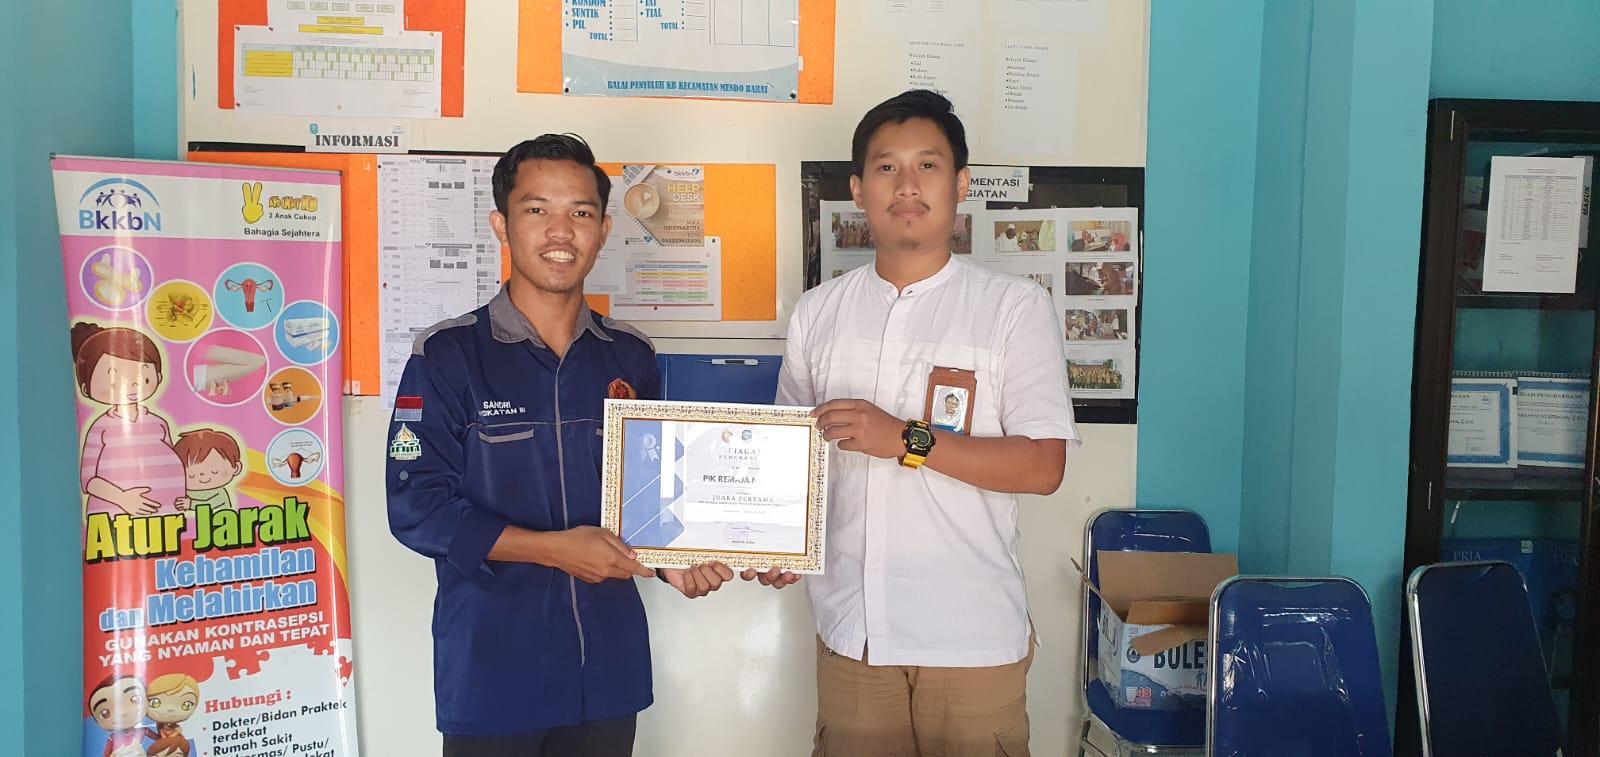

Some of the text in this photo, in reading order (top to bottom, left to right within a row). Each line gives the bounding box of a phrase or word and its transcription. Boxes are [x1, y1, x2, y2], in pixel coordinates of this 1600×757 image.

[571, 8, 599, 18] SUNTIK
[645, 8, 662, 18] TIAL
[572, 20, 586, 29] PIL
[660, 22, 679, 30] TOTAL
[589, 32, 608, 41] TOTAL
[608, 80, 768, 94] BALAI PENYULUH KB KECAMATAN MENDO BARAT
[315, 134, 399, 147] INFORMASI
[667, 183, 699, 193] HELP
[970, 178, 1020, 187] MENTASI
[673, 193, 700, 202] DESK
[966, 189, 1007, 198] GIATAN
[79, 209, 162, 231] BkkbN
[294, 213, 317, 221] Cukup
[244, 228, 320, 238] Bahagia Sejahtera
[483, 400, 511, 409] SANDRI
[713, 494, 774, 503] JUARA PERTAMA
[86, 496, 312, 563] Atur Jarak
[155, 547, 316, 592] Kehamilan
[99, 579, 317, 632] dan Melahirkan
[105, 611, 324, 652] GUNAKAN KONTRASEPSI
[99, 624, 330, 668] YANG NYAMAN DAN TEPAT
[204, 689, 282, 713] Hubungi
[213, 710, 297, 731] Dokter/Bidan
[213, 726, 267, 744] terdekat
[213, 733, 293, 756] Rumah Sakit
[292, 737, 329, 753] Pustu/
